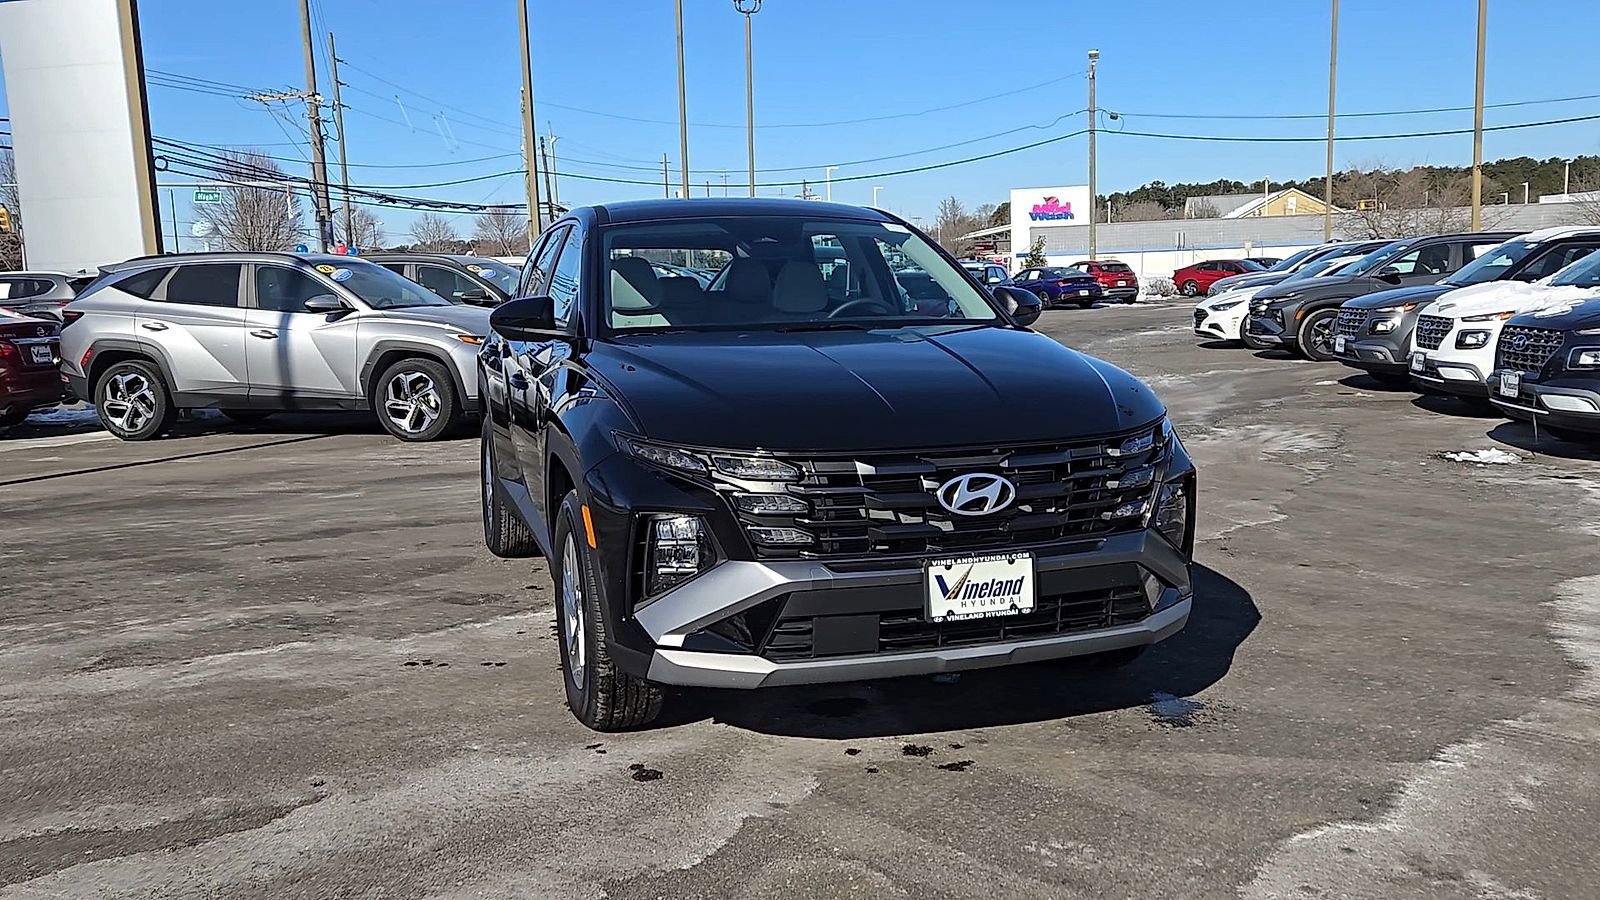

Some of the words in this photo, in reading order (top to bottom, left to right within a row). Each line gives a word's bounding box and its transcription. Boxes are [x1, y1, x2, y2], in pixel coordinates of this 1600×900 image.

[931, 552, 1030, 566] VINELANDHYUNDAI.COM
[934, 564, 1025, 601] Vineland
[961, 597, 1021, 608] HYUNDAI
[946, 612, 984, 622] VINELAND
[985, 608, 1019, 618] HYUNDAI
